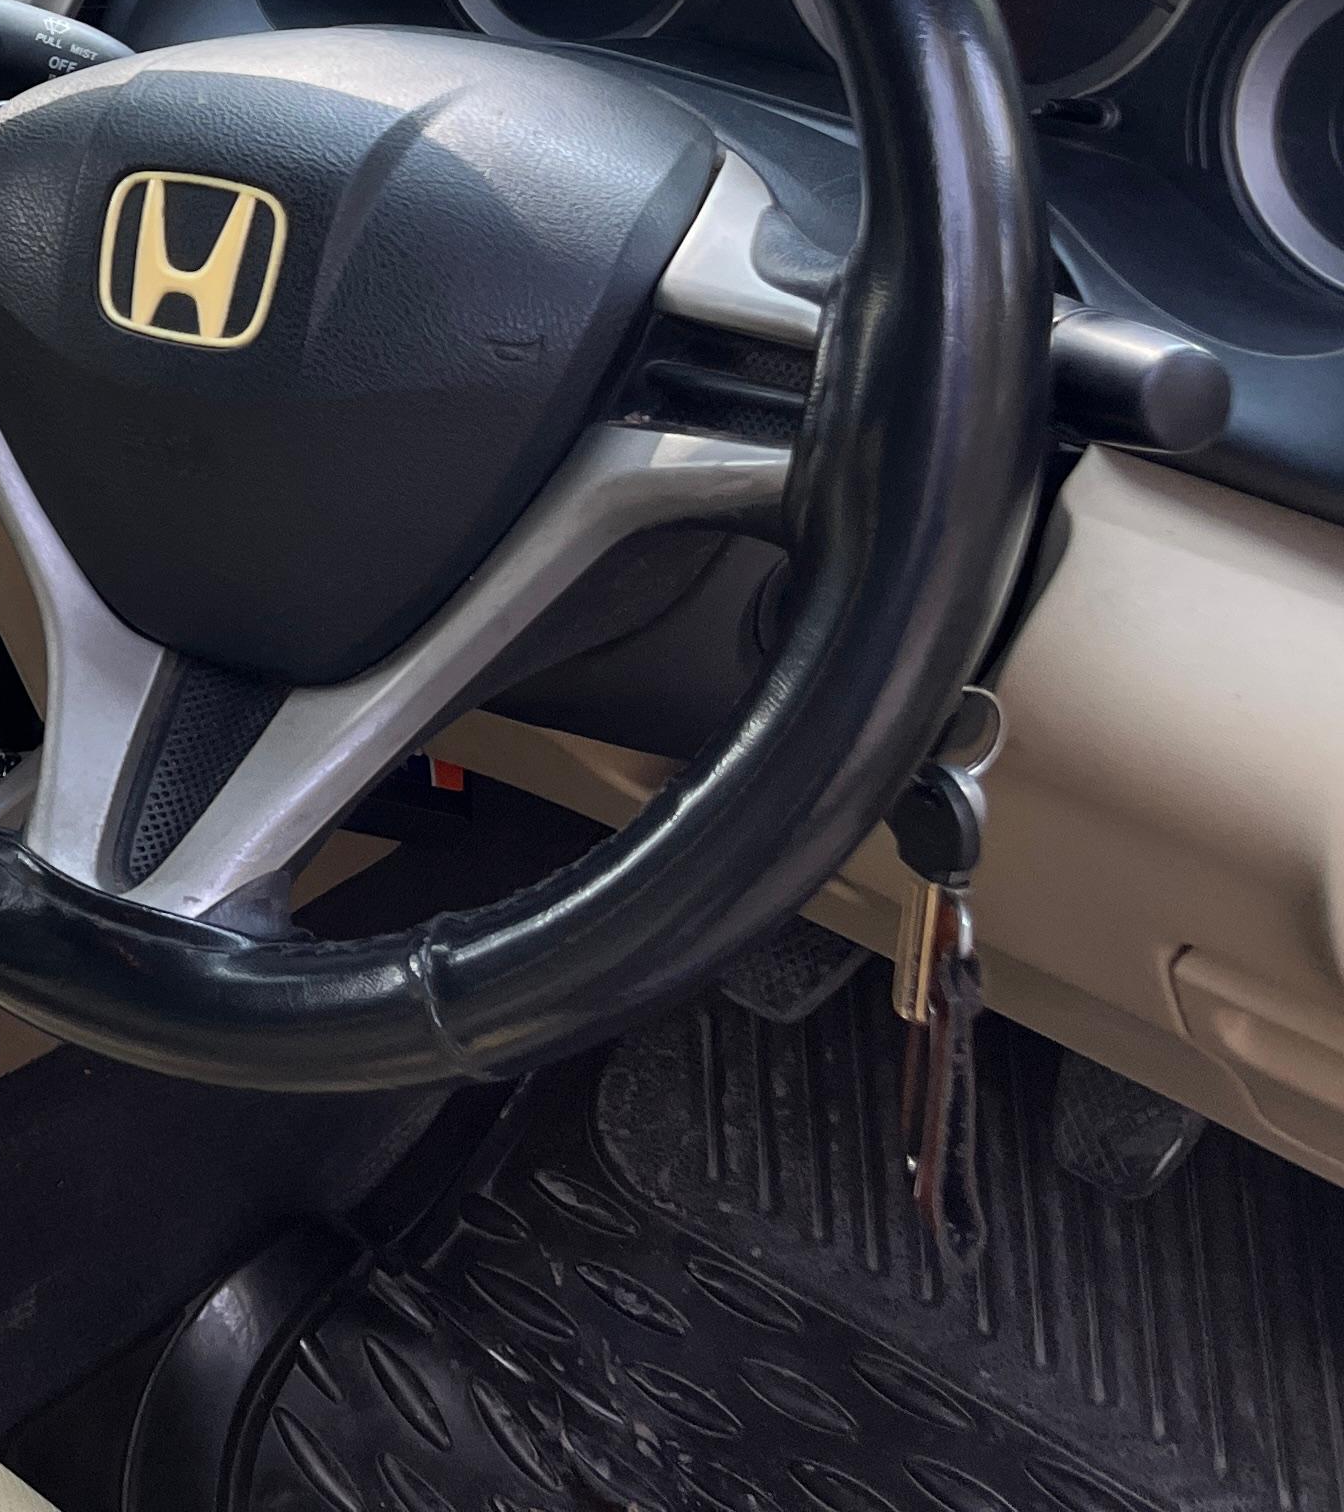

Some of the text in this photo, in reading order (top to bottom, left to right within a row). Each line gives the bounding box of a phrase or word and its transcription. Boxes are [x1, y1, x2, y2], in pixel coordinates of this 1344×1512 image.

[35, 32, 99, 61] PULL MIST
[48, 55, 78, 73] OFF
